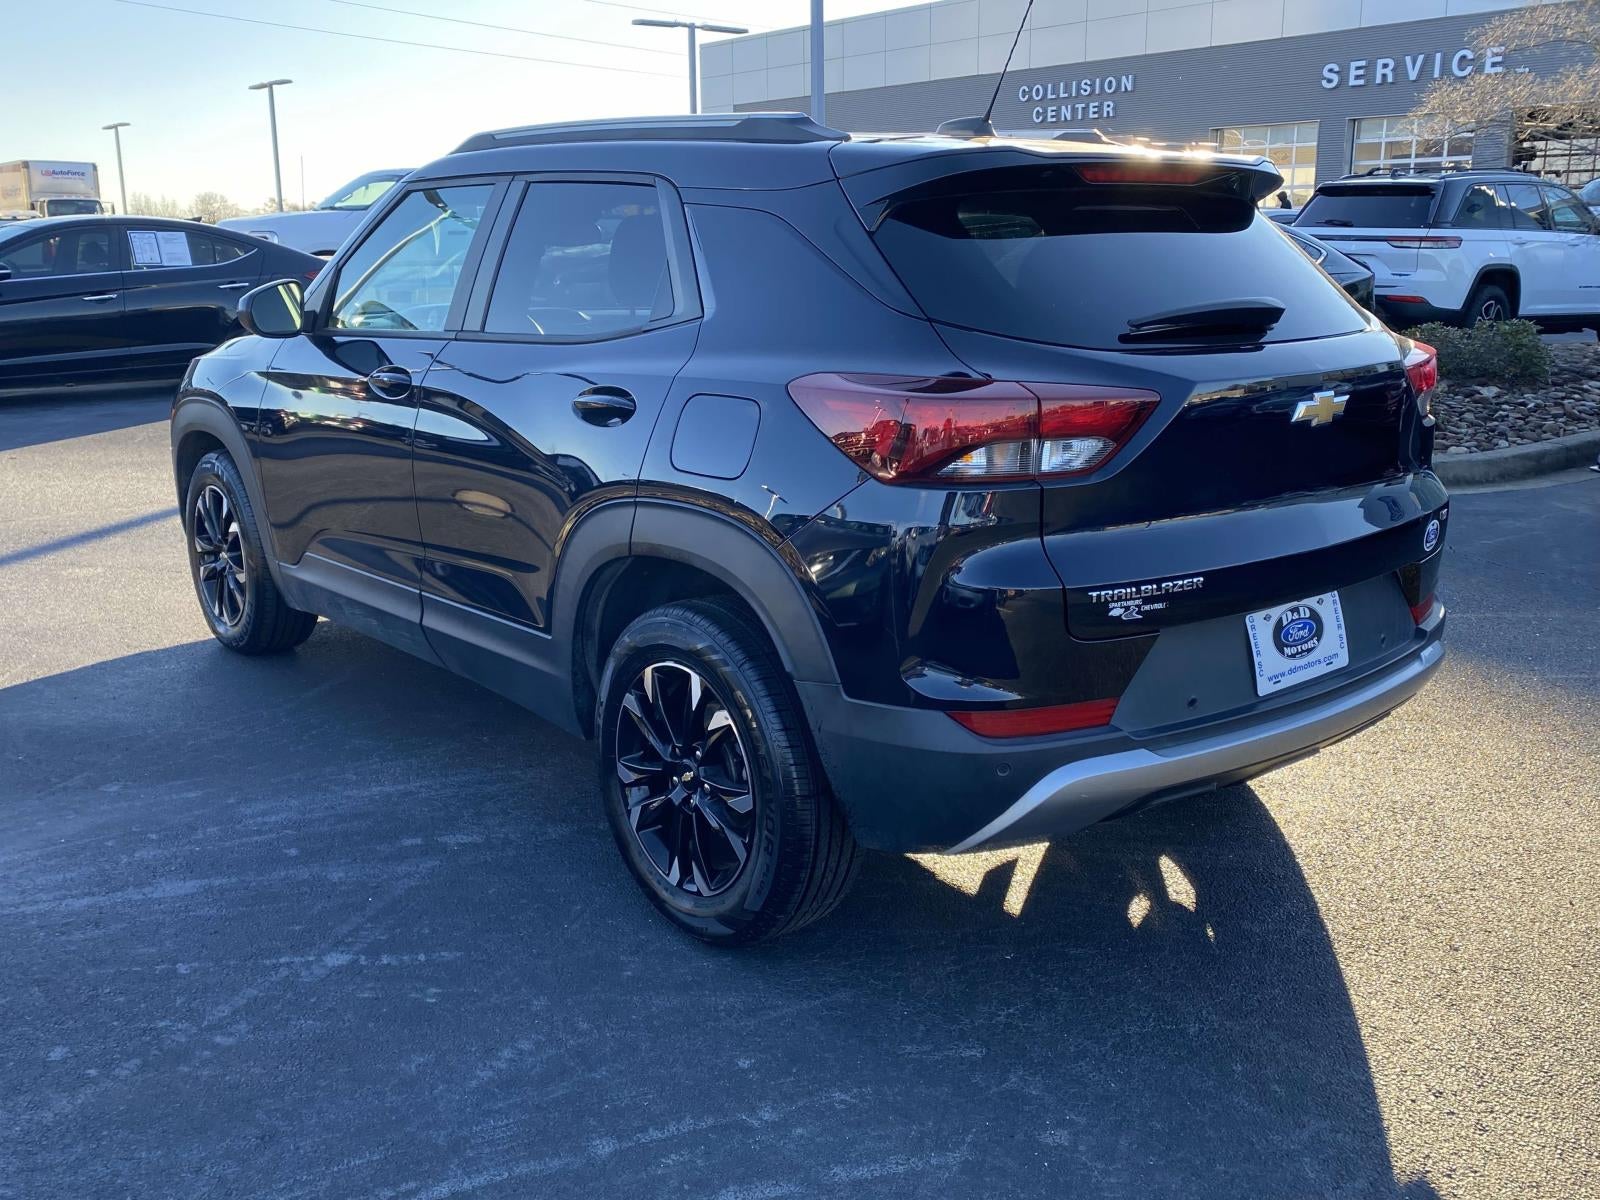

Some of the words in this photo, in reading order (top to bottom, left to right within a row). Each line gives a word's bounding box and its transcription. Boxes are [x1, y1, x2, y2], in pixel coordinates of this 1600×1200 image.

[1321, 46, 1505, 89] SERVICE
[1019, 75, 1134, 102] COLLISION
[1032, 101, 1115, 123] CENTER
[1088, 577, 1204, 603] TRAILBLAZER
[1108, 599, 1143, 609] SPARTANBURG
[1281, 606, 1311, 627] D&D
[1288, 623, 1310, 642] Ford
[1330, 592, 1345, 631] GREER
[1338, 634, 1345, 649] SC
[1248, 616, 1261, 658] GREER
[1257, 661, 1264, 678] SC
[1283, 637, 1319, 657] MOTORS
[1267, 652, 1339, 682] www.ddmotors.com
